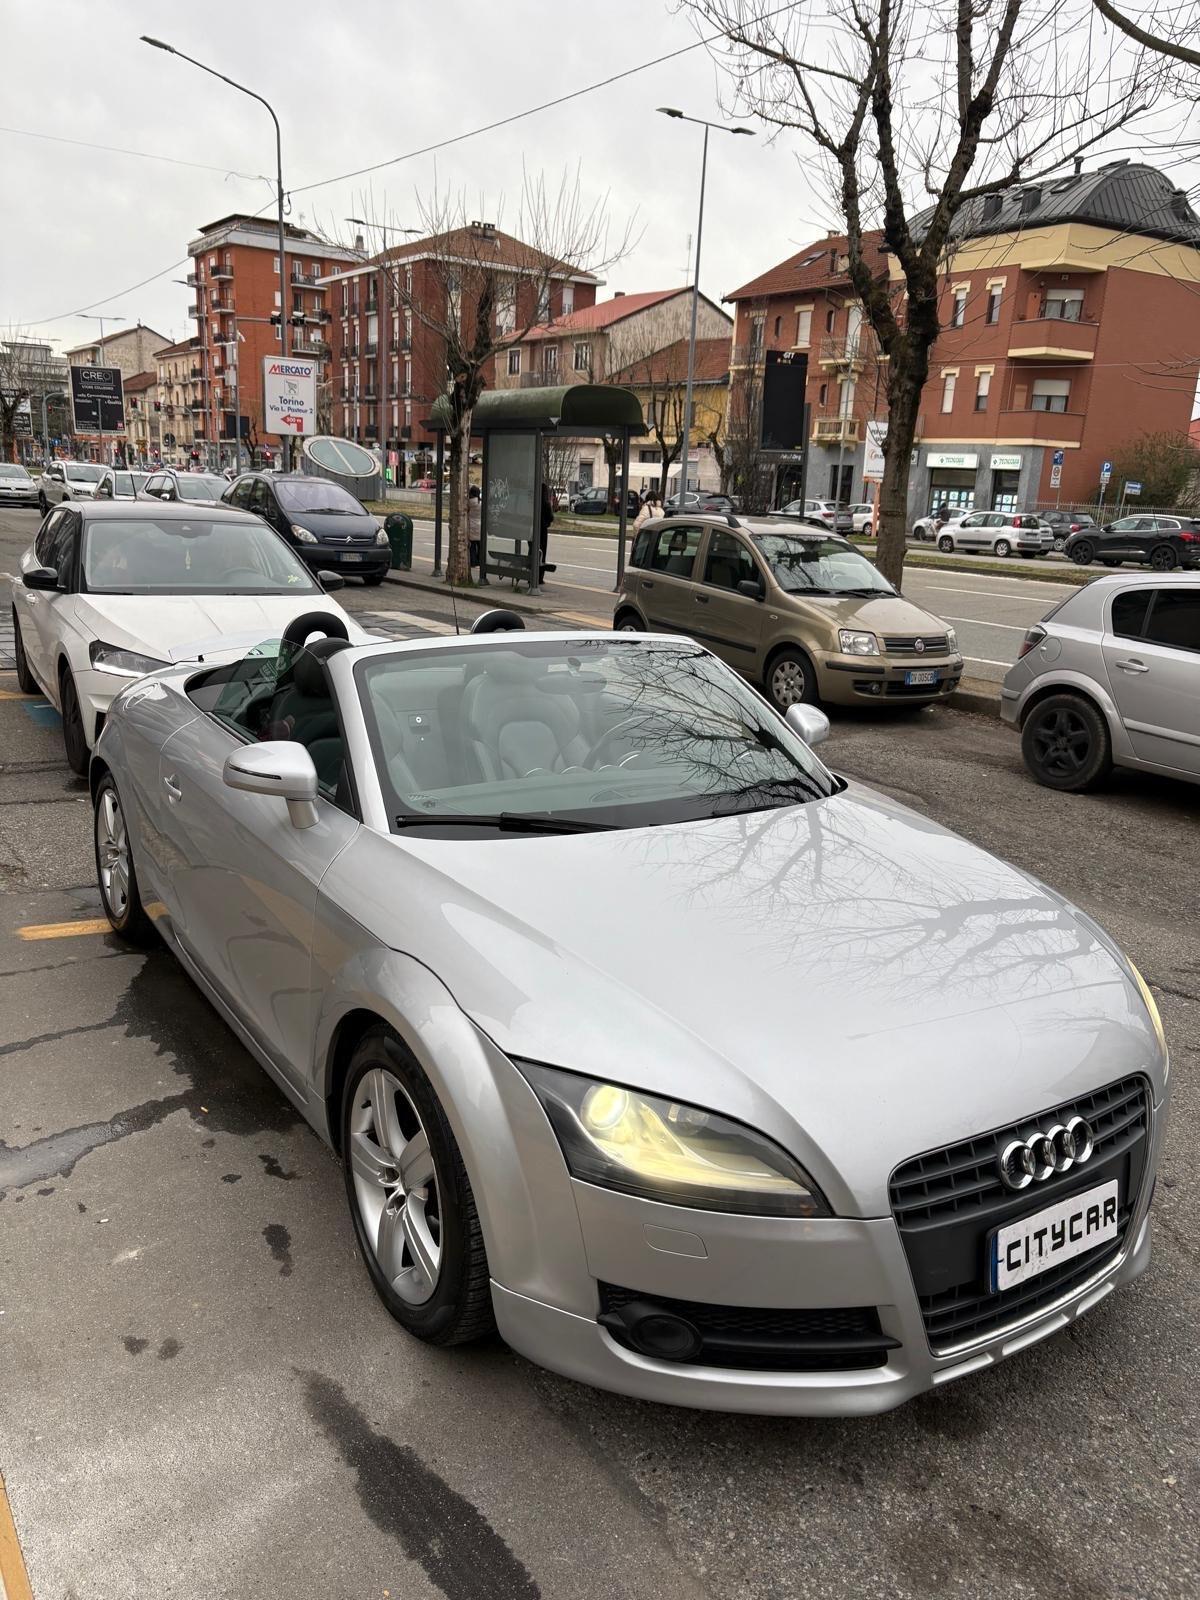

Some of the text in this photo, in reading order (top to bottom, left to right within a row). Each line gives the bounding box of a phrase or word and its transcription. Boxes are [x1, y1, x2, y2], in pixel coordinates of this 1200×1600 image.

[279, 395, 304, 406] Torino
[269, 404, 280, 412] Via
[1103, 462, 1111, 472] P
[1007, 1196, 1116, 1272] CITYCAR
